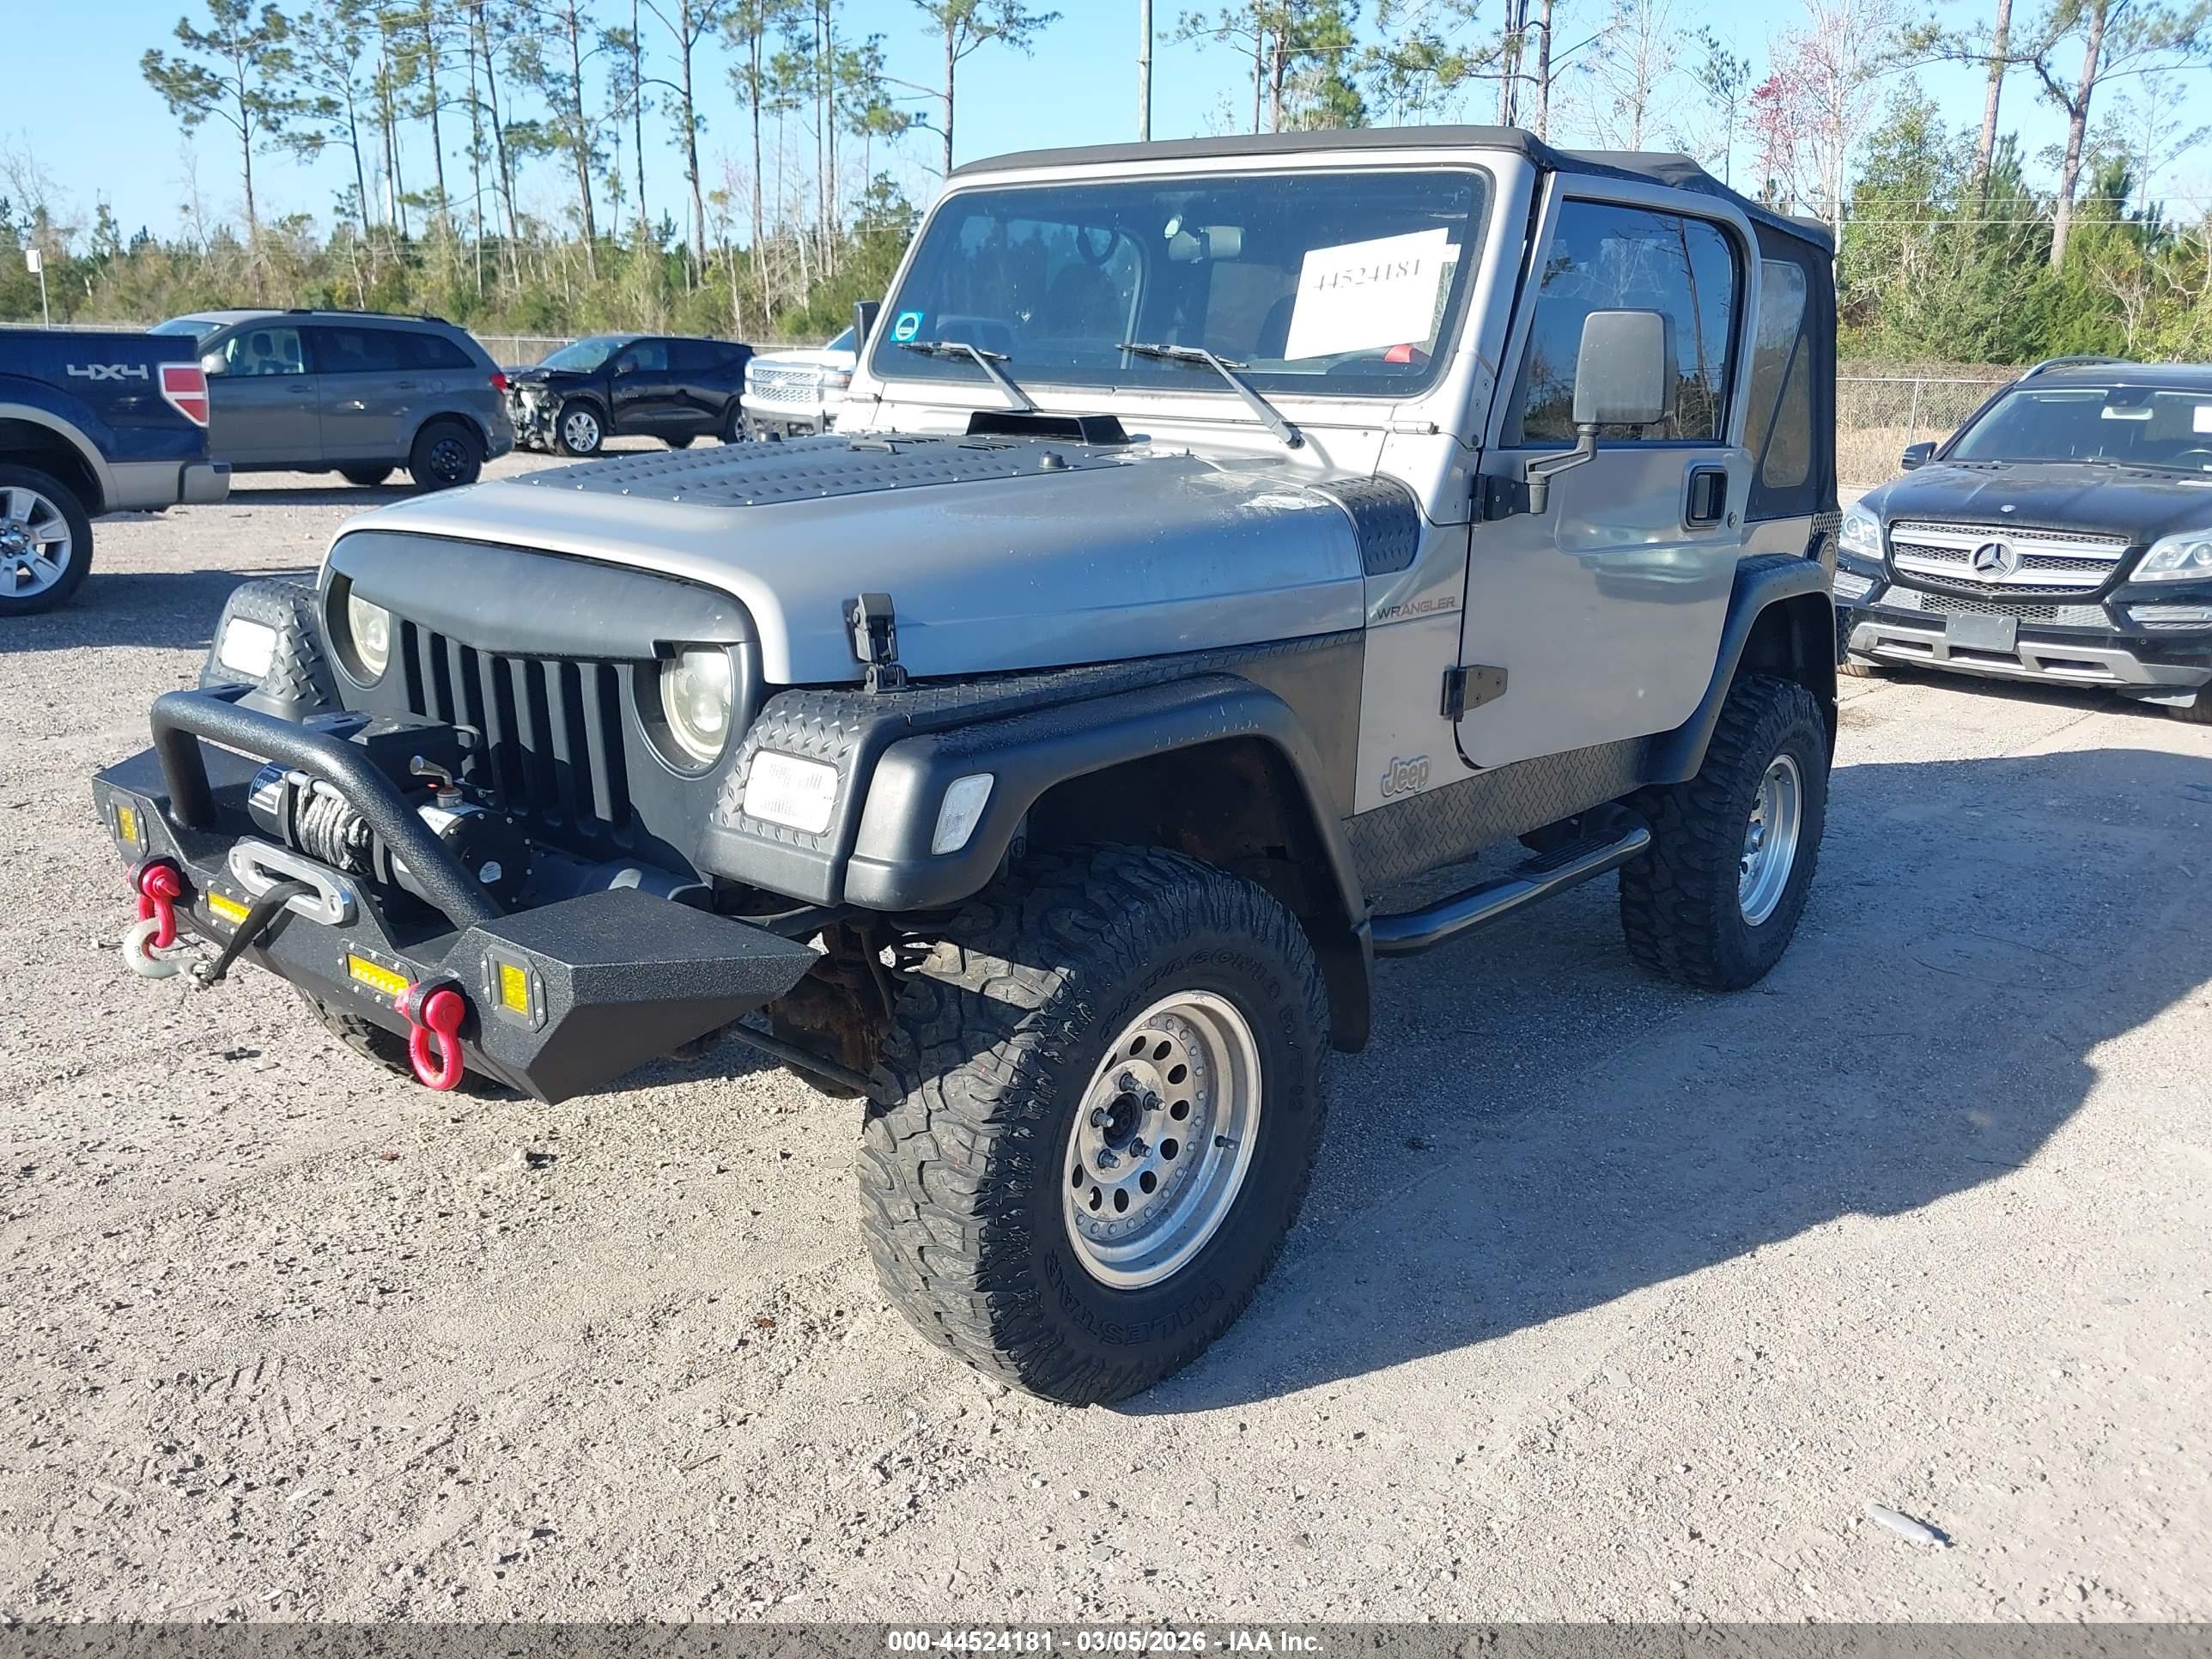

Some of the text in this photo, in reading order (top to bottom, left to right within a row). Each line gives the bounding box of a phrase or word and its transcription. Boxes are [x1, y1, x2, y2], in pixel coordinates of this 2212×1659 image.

[1312, 258, 1422, 292] 44524181
[1376, 596, 1456, 620] WRANGLER
[1381, 756, 1431, 797] Jeep
[1043, 1248, 1226, 1347] MILESTAR
